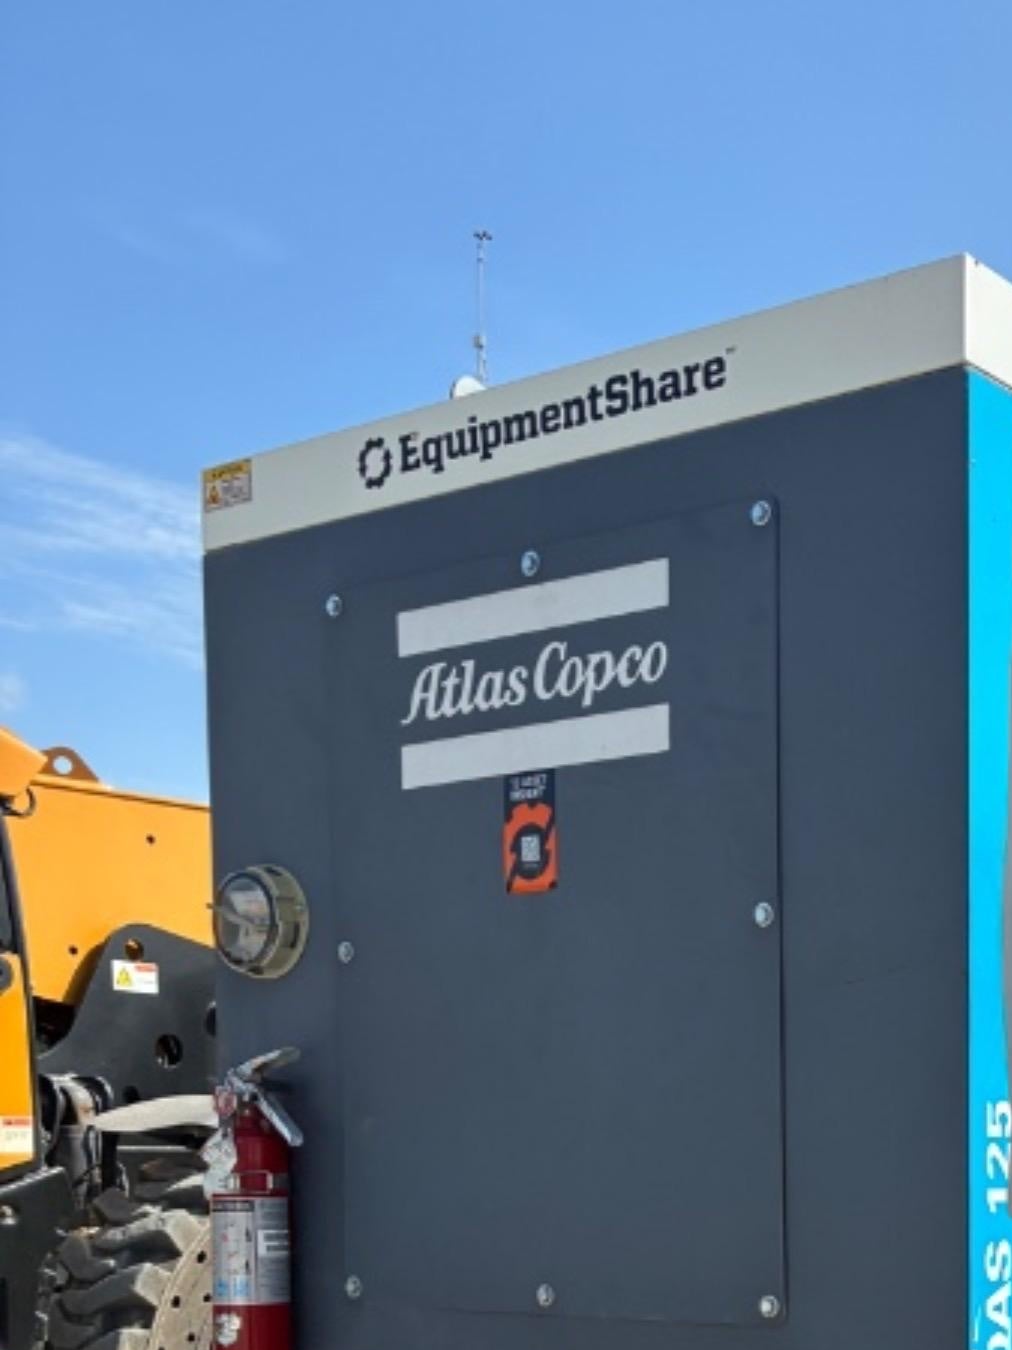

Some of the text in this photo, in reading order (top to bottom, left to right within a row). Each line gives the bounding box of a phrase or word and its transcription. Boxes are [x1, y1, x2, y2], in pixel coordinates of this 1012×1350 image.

[399, 355, 726, 474] EquipmentShare
[401, 641, 667, 724] Atlas Copco
[986, 1100, 1012, 1214] 125
